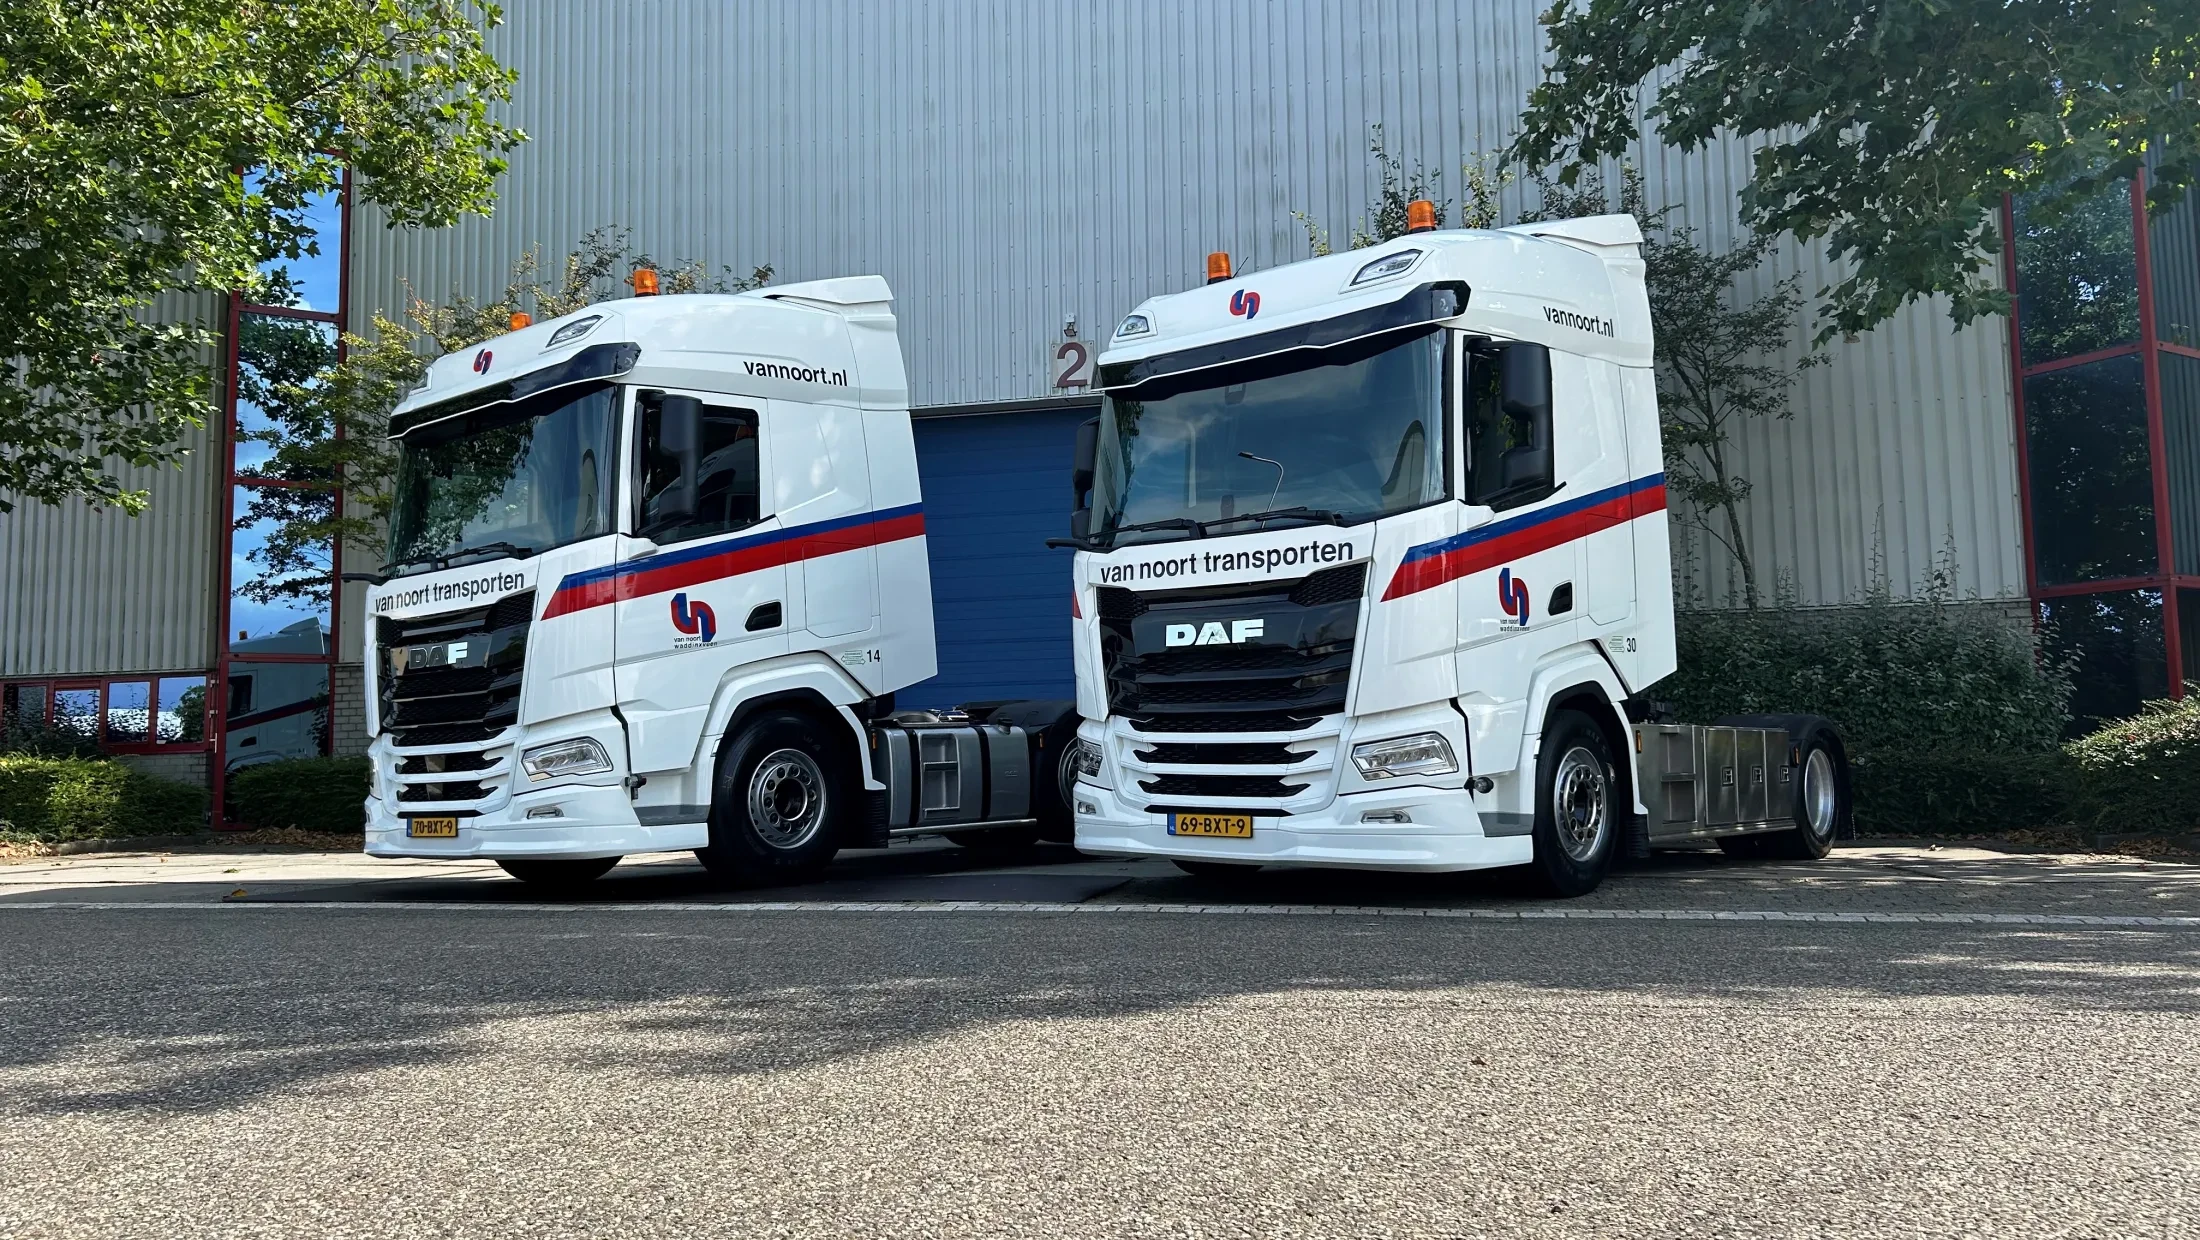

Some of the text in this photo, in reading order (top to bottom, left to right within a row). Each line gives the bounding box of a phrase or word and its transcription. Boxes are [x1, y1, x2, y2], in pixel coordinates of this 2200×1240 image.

[1543, 306, 1614, 338] vannoort.nl
[743, 361, 848, 387] vannoort.nl
[1056, 342, 1088, 387] 2
[1100, 540, 1353, 583] van noort transporten
[375, 572, 525, 613] van noort transporten
[1165, 618, 1264, 647] DAF
[1626, 637, 1637, 653] 30
[409, 641, 468, 670] DAF
[866, 649, 881, 663] 14
[414, 820, 453, 834] 70-BXT-9
[1180, 816, 1246, 834] 69-BXT-9
